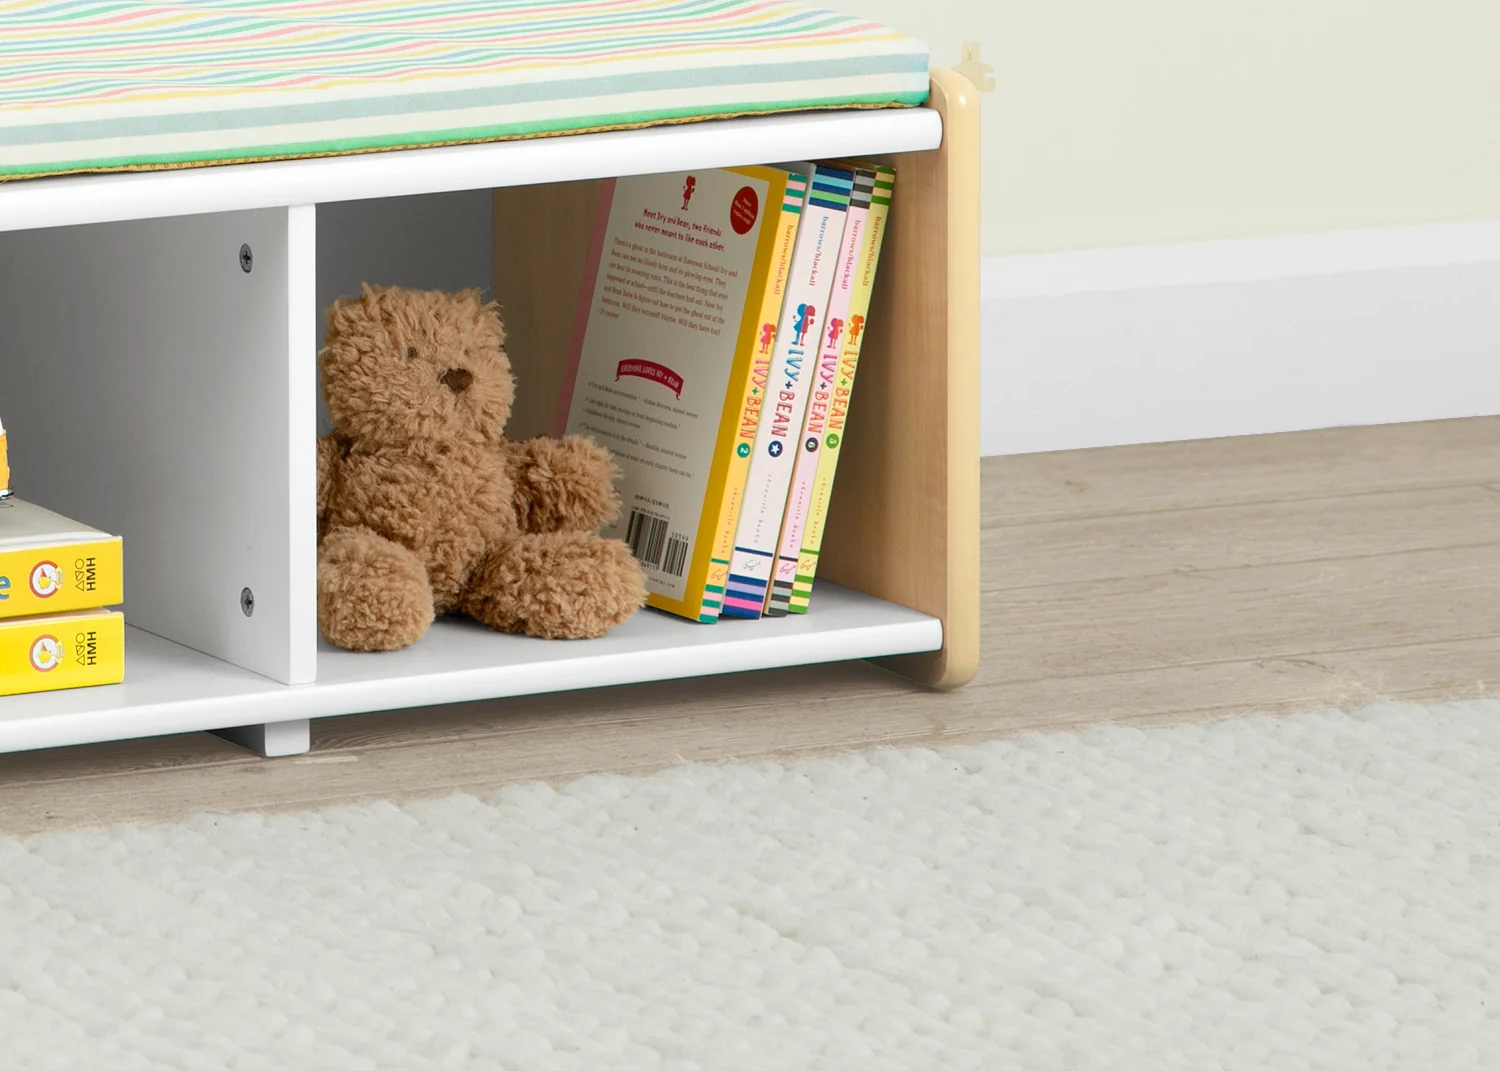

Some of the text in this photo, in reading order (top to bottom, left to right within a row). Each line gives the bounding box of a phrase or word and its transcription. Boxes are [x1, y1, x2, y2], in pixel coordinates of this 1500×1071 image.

[643, 207, 656, 218] Meet
[774, 224, 794, 295] barrows/blackall
[809, 216, 829, 286] barrows/blackall
[842, 220, 861, 290] barrows/blackall
[863, 216, 882, 286] barrows/blackall
[752, 359, 770, 389] IVY
[784, 349, 804, 382] IVY
[820, 353, 838, 384] IVY
[841, 350, 858, 380] IVY
[740, 396, 762, 439] BEAN
[771, 390, 795, 437] BEAN
[808, 390, 829, 434] BEAN
[828, 387, 850, 430] BEAN
[86, 557, 96, 591] HMH
[87, 631, 97, 666] HMH
